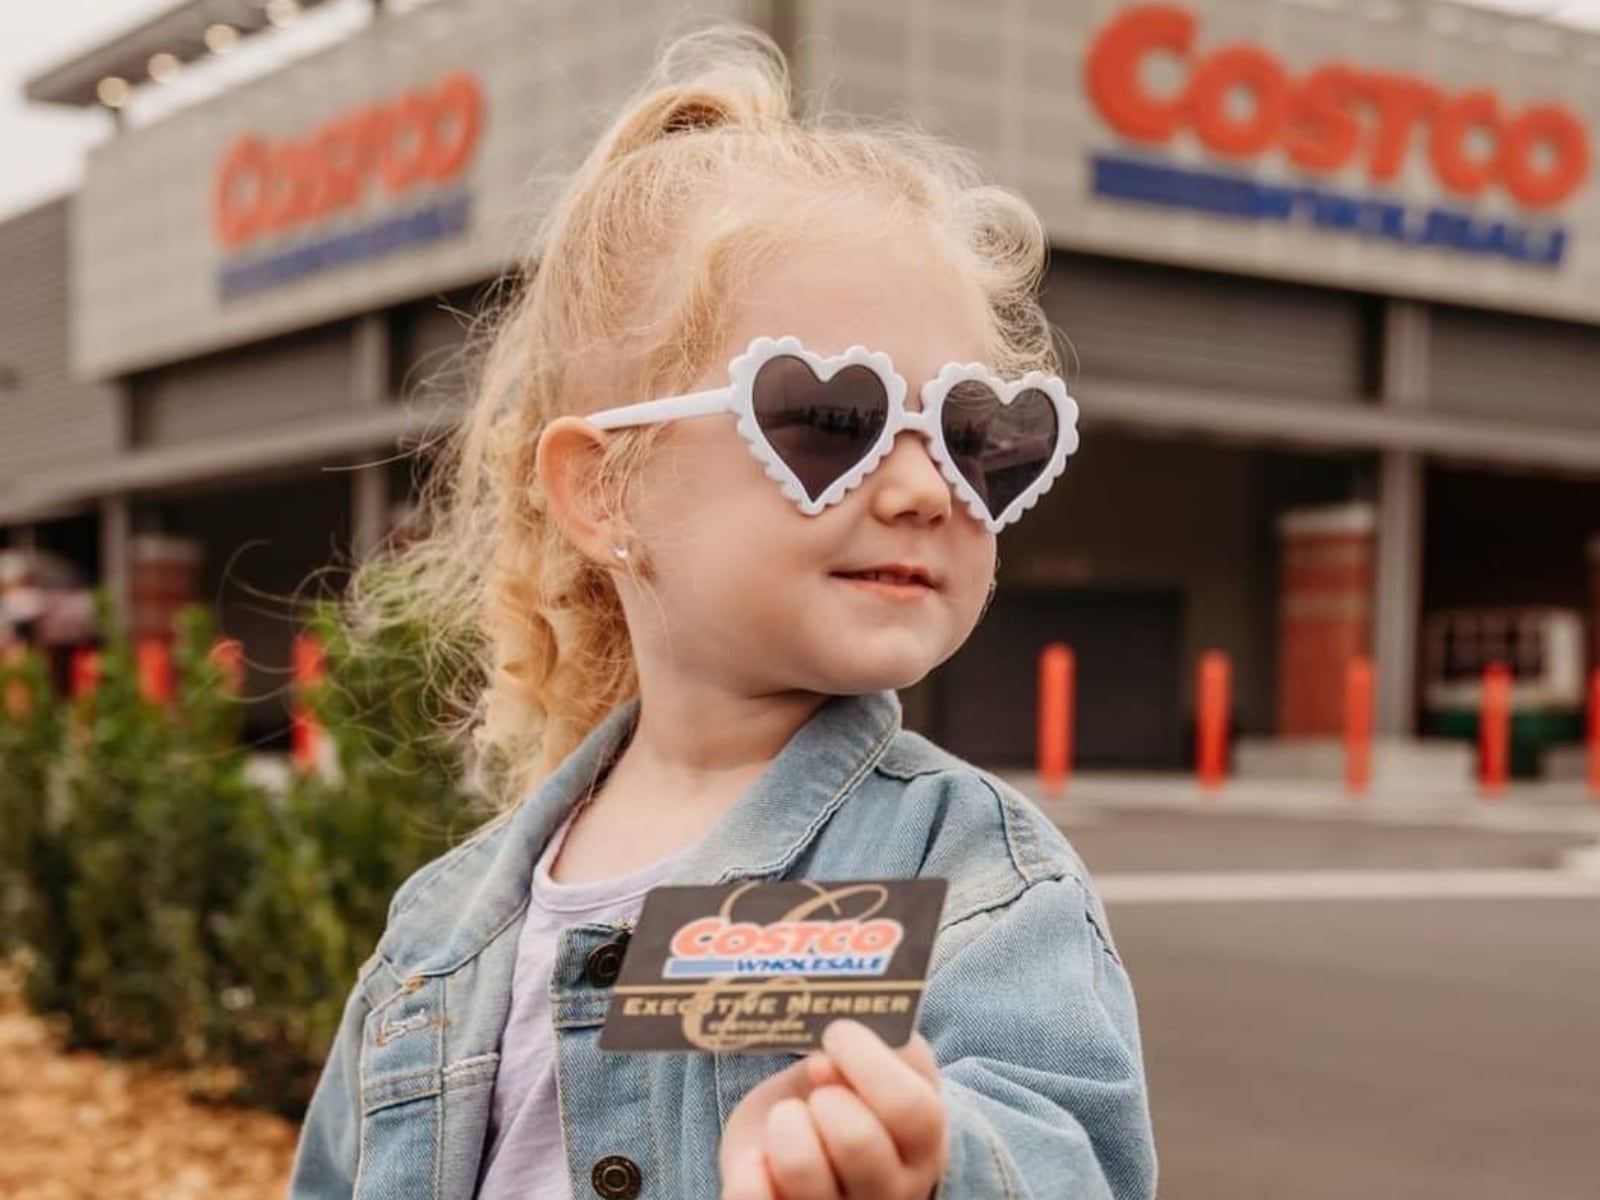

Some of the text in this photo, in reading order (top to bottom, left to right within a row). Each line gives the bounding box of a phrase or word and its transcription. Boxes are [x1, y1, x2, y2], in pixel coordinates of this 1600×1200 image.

[1084, 4, 1590, 208] COSTCO
[672, 917, 903, 956] COSTCO
[736, 956, 885, 973] WHOLESALE
[623, 995, 911, 1016] EXECUTIVE MEMBER
